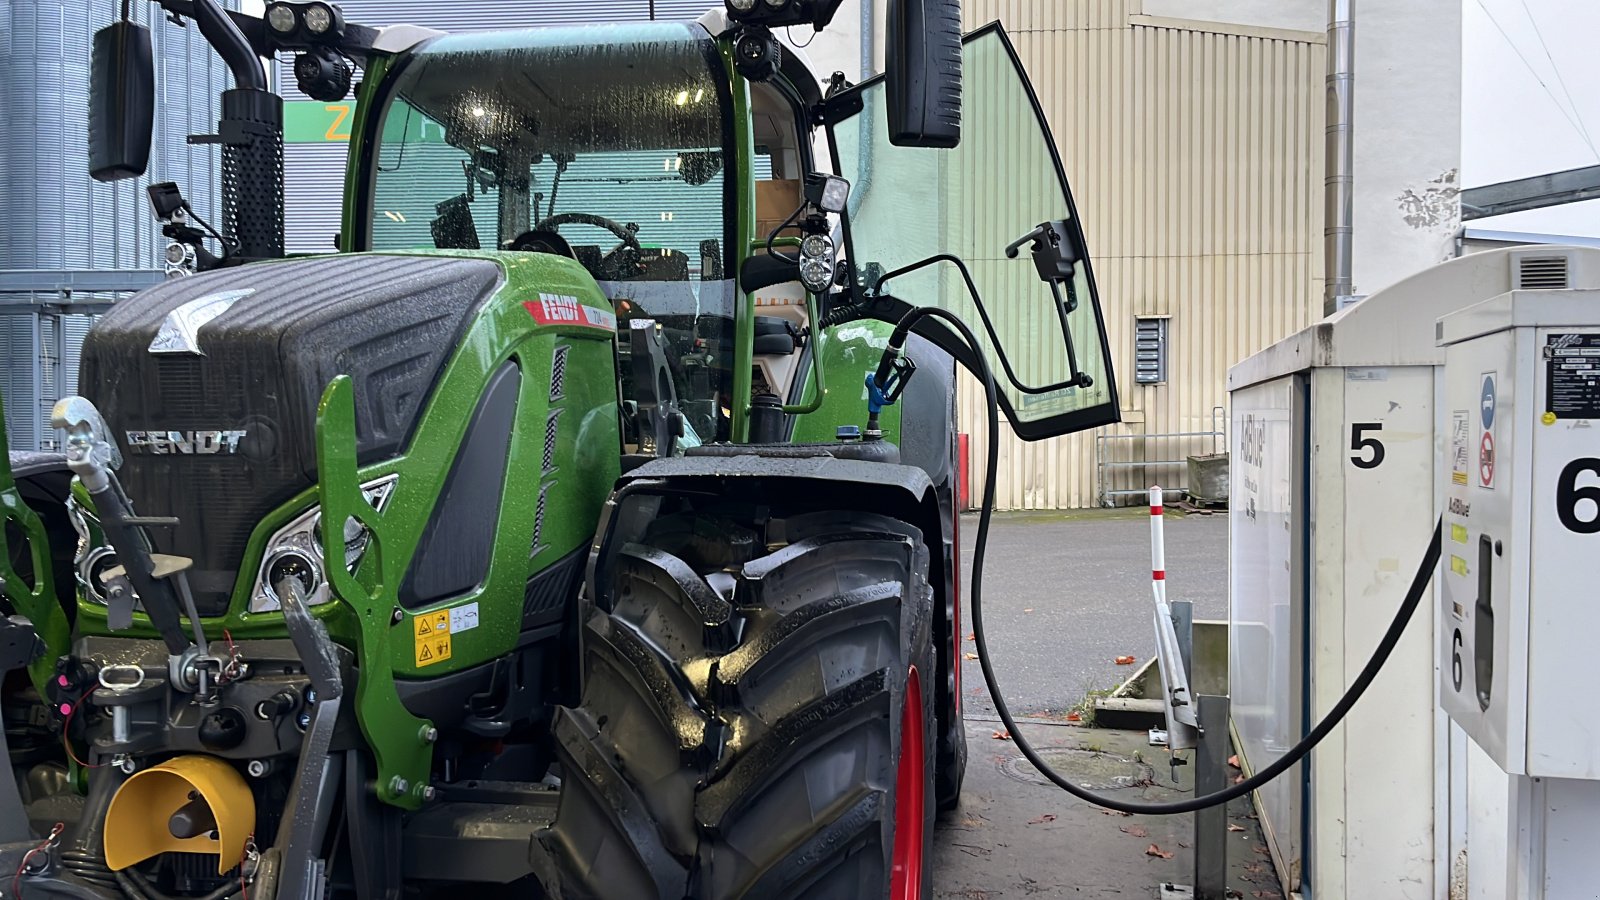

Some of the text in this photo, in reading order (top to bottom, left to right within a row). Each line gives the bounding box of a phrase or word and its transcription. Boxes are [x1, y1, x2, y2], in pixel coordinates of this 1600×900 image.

[538, 293, 580, 321] FENDT
[125, 430, 247, 455] FENDT
[1350, 422, 1386, 470] 5
[1557, 457, 1600, 534] 6
[1452, 627, 1463, 693] 6
